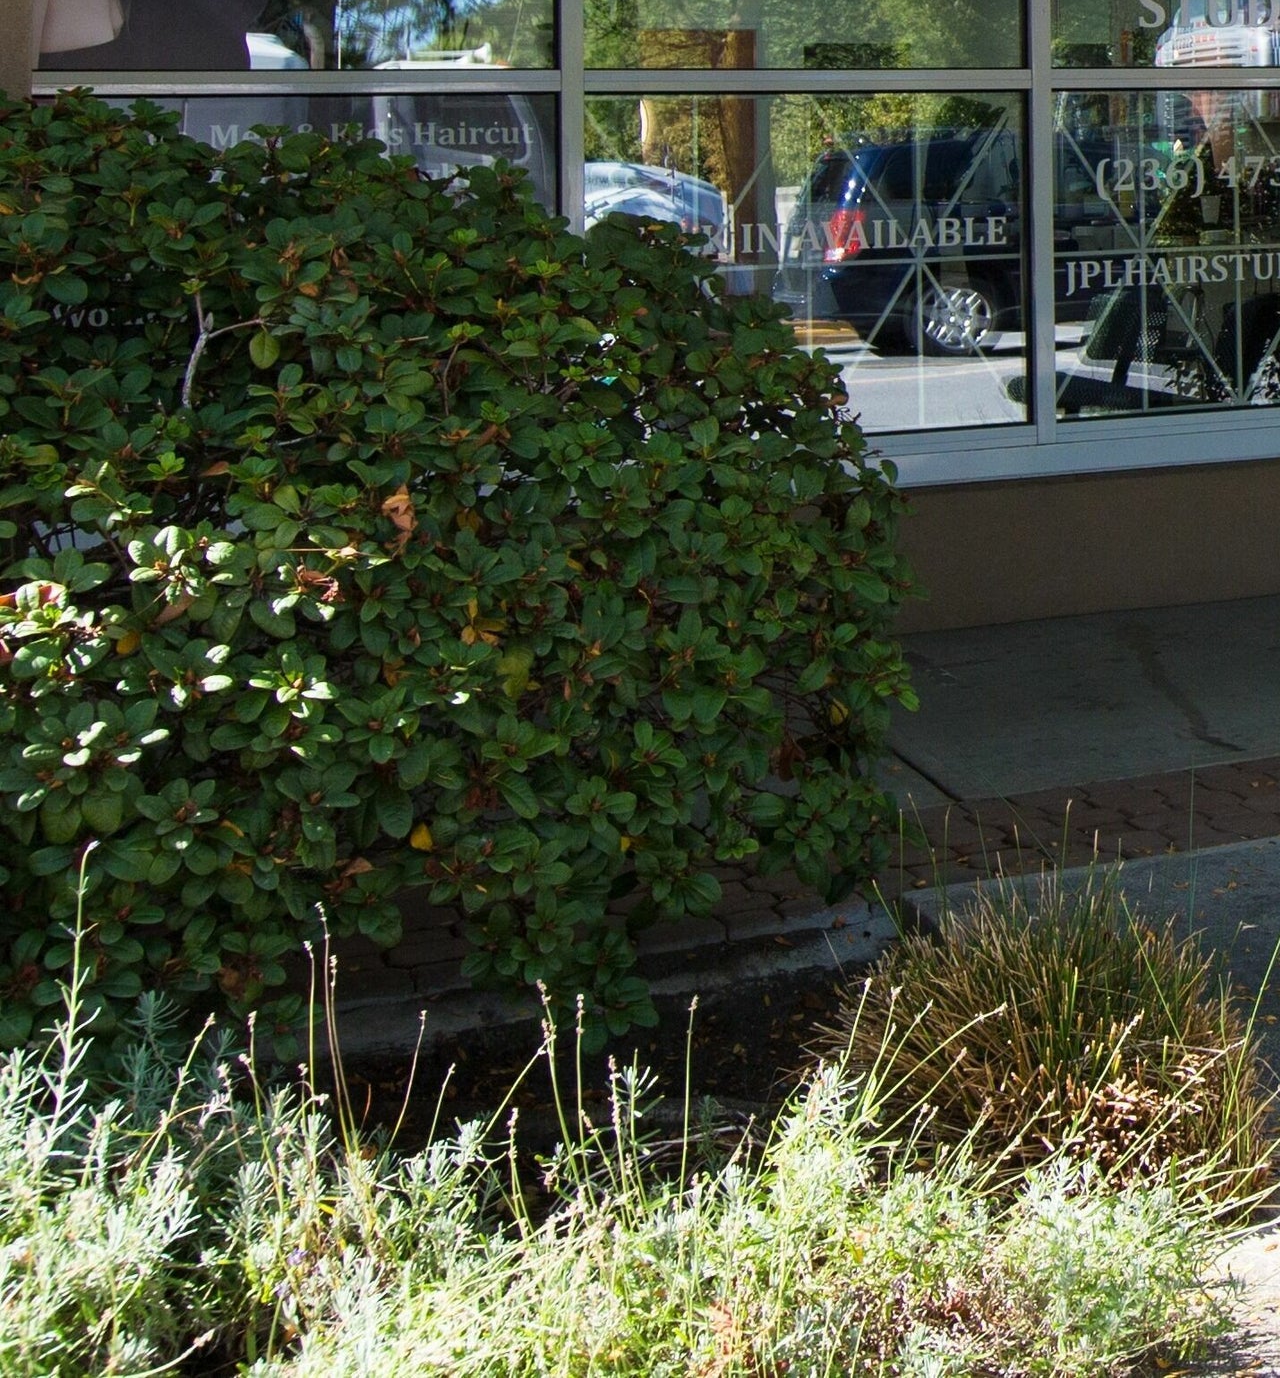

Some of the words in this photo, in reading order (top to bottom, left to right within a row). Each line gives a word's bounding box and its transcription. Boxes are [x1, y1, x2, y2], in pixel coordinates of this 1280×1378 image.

[412, 121, 535, 146] Haircut
[1095, 157, 1205, 201] (236)
[740, 222, 786, 254] IN
[798, 215, 1008, 254] AVAILABLE
